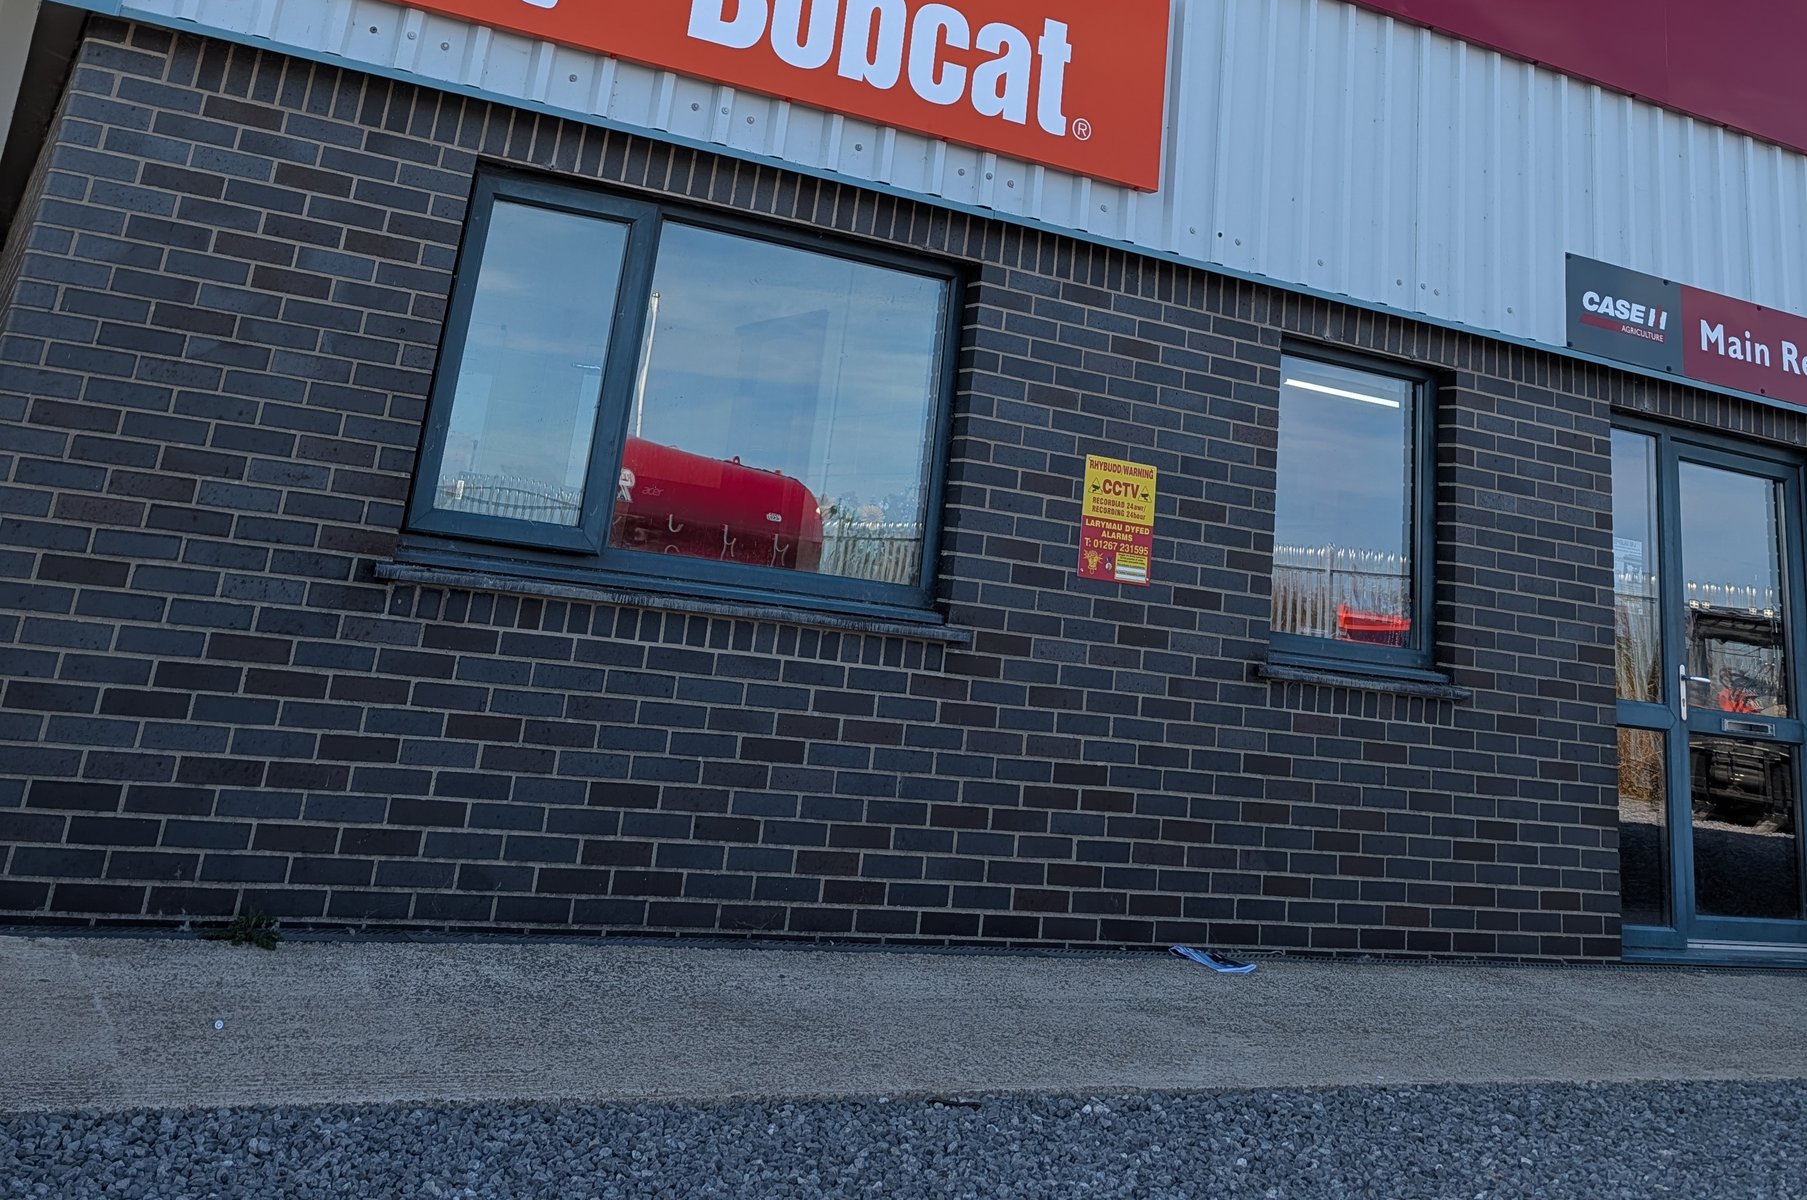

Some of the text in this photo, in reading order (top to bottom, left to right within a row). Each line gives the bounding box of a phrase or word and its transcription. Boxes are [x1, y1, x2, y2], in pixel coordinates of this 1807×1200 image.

[1582, 290, 1646, 325] CASE
[1621, 324, 1665, 343] AGRICULTURE
[1700, 319, 1770, 368] Main
[1102, 478, 1140, 499] CCTV
[1092, 496, 1125, 508] RECORDIAD
[1092, 505, 1146, 520] RECORDING 24hour
[1085, 519, 1150, 535] LARYMAU DYFED
[1101, 530, 1133, 542] ALARMS
[1093, 539, 1118, 551] 01267
[1119, 543, 1149, 555] 231595
